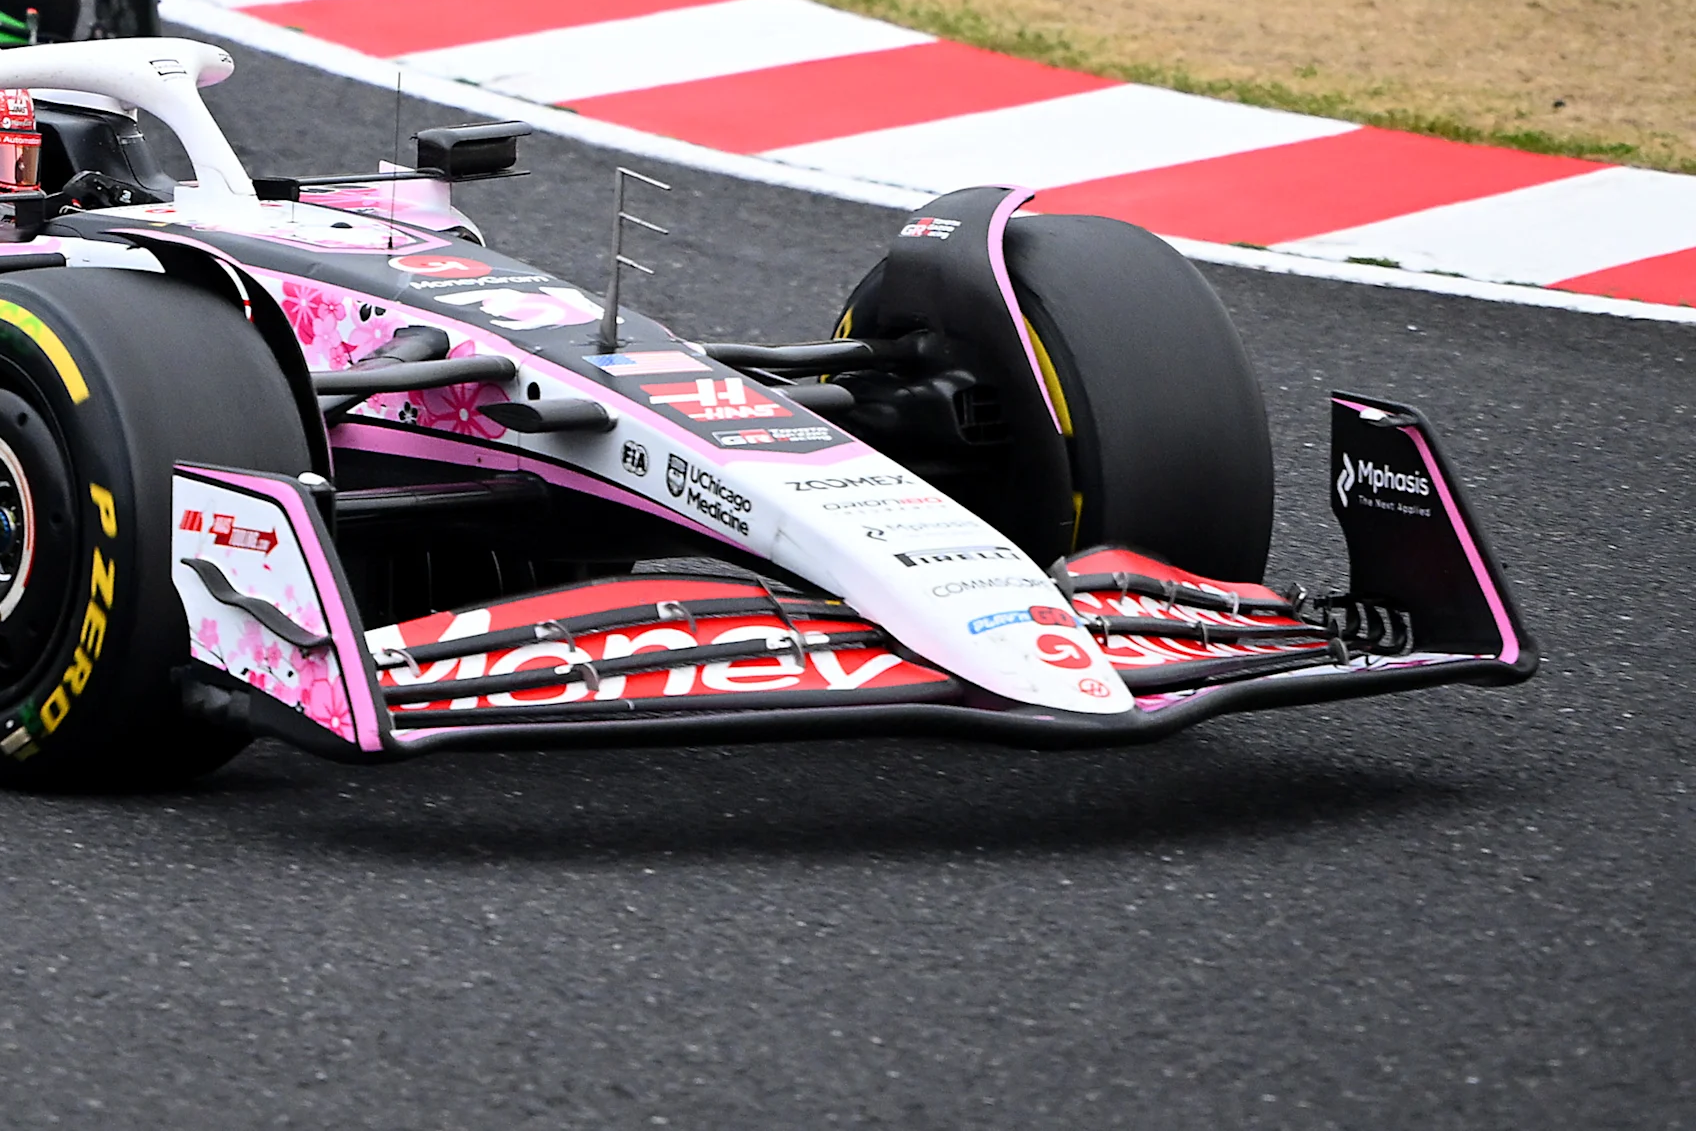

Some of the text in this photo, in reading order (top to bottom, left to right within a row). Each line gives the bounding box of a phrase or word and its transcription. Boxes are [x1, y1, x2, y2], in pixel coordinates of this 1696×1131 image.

[410, 275, 550, 290] MoneyGram
[688, 403, 781, 420] HAAS
[623, 447, 645, 470] FIA
[690, 465, 752, 513] UChicago
[785, 474, 915, 491] ZOOMEX
[1358, 459, 1430, 496] Mphasis
[687, 487, 749, 536] Medicine
[1358, 494, 1374, 507] The
[40, 483, 118, 735] P ZERO
